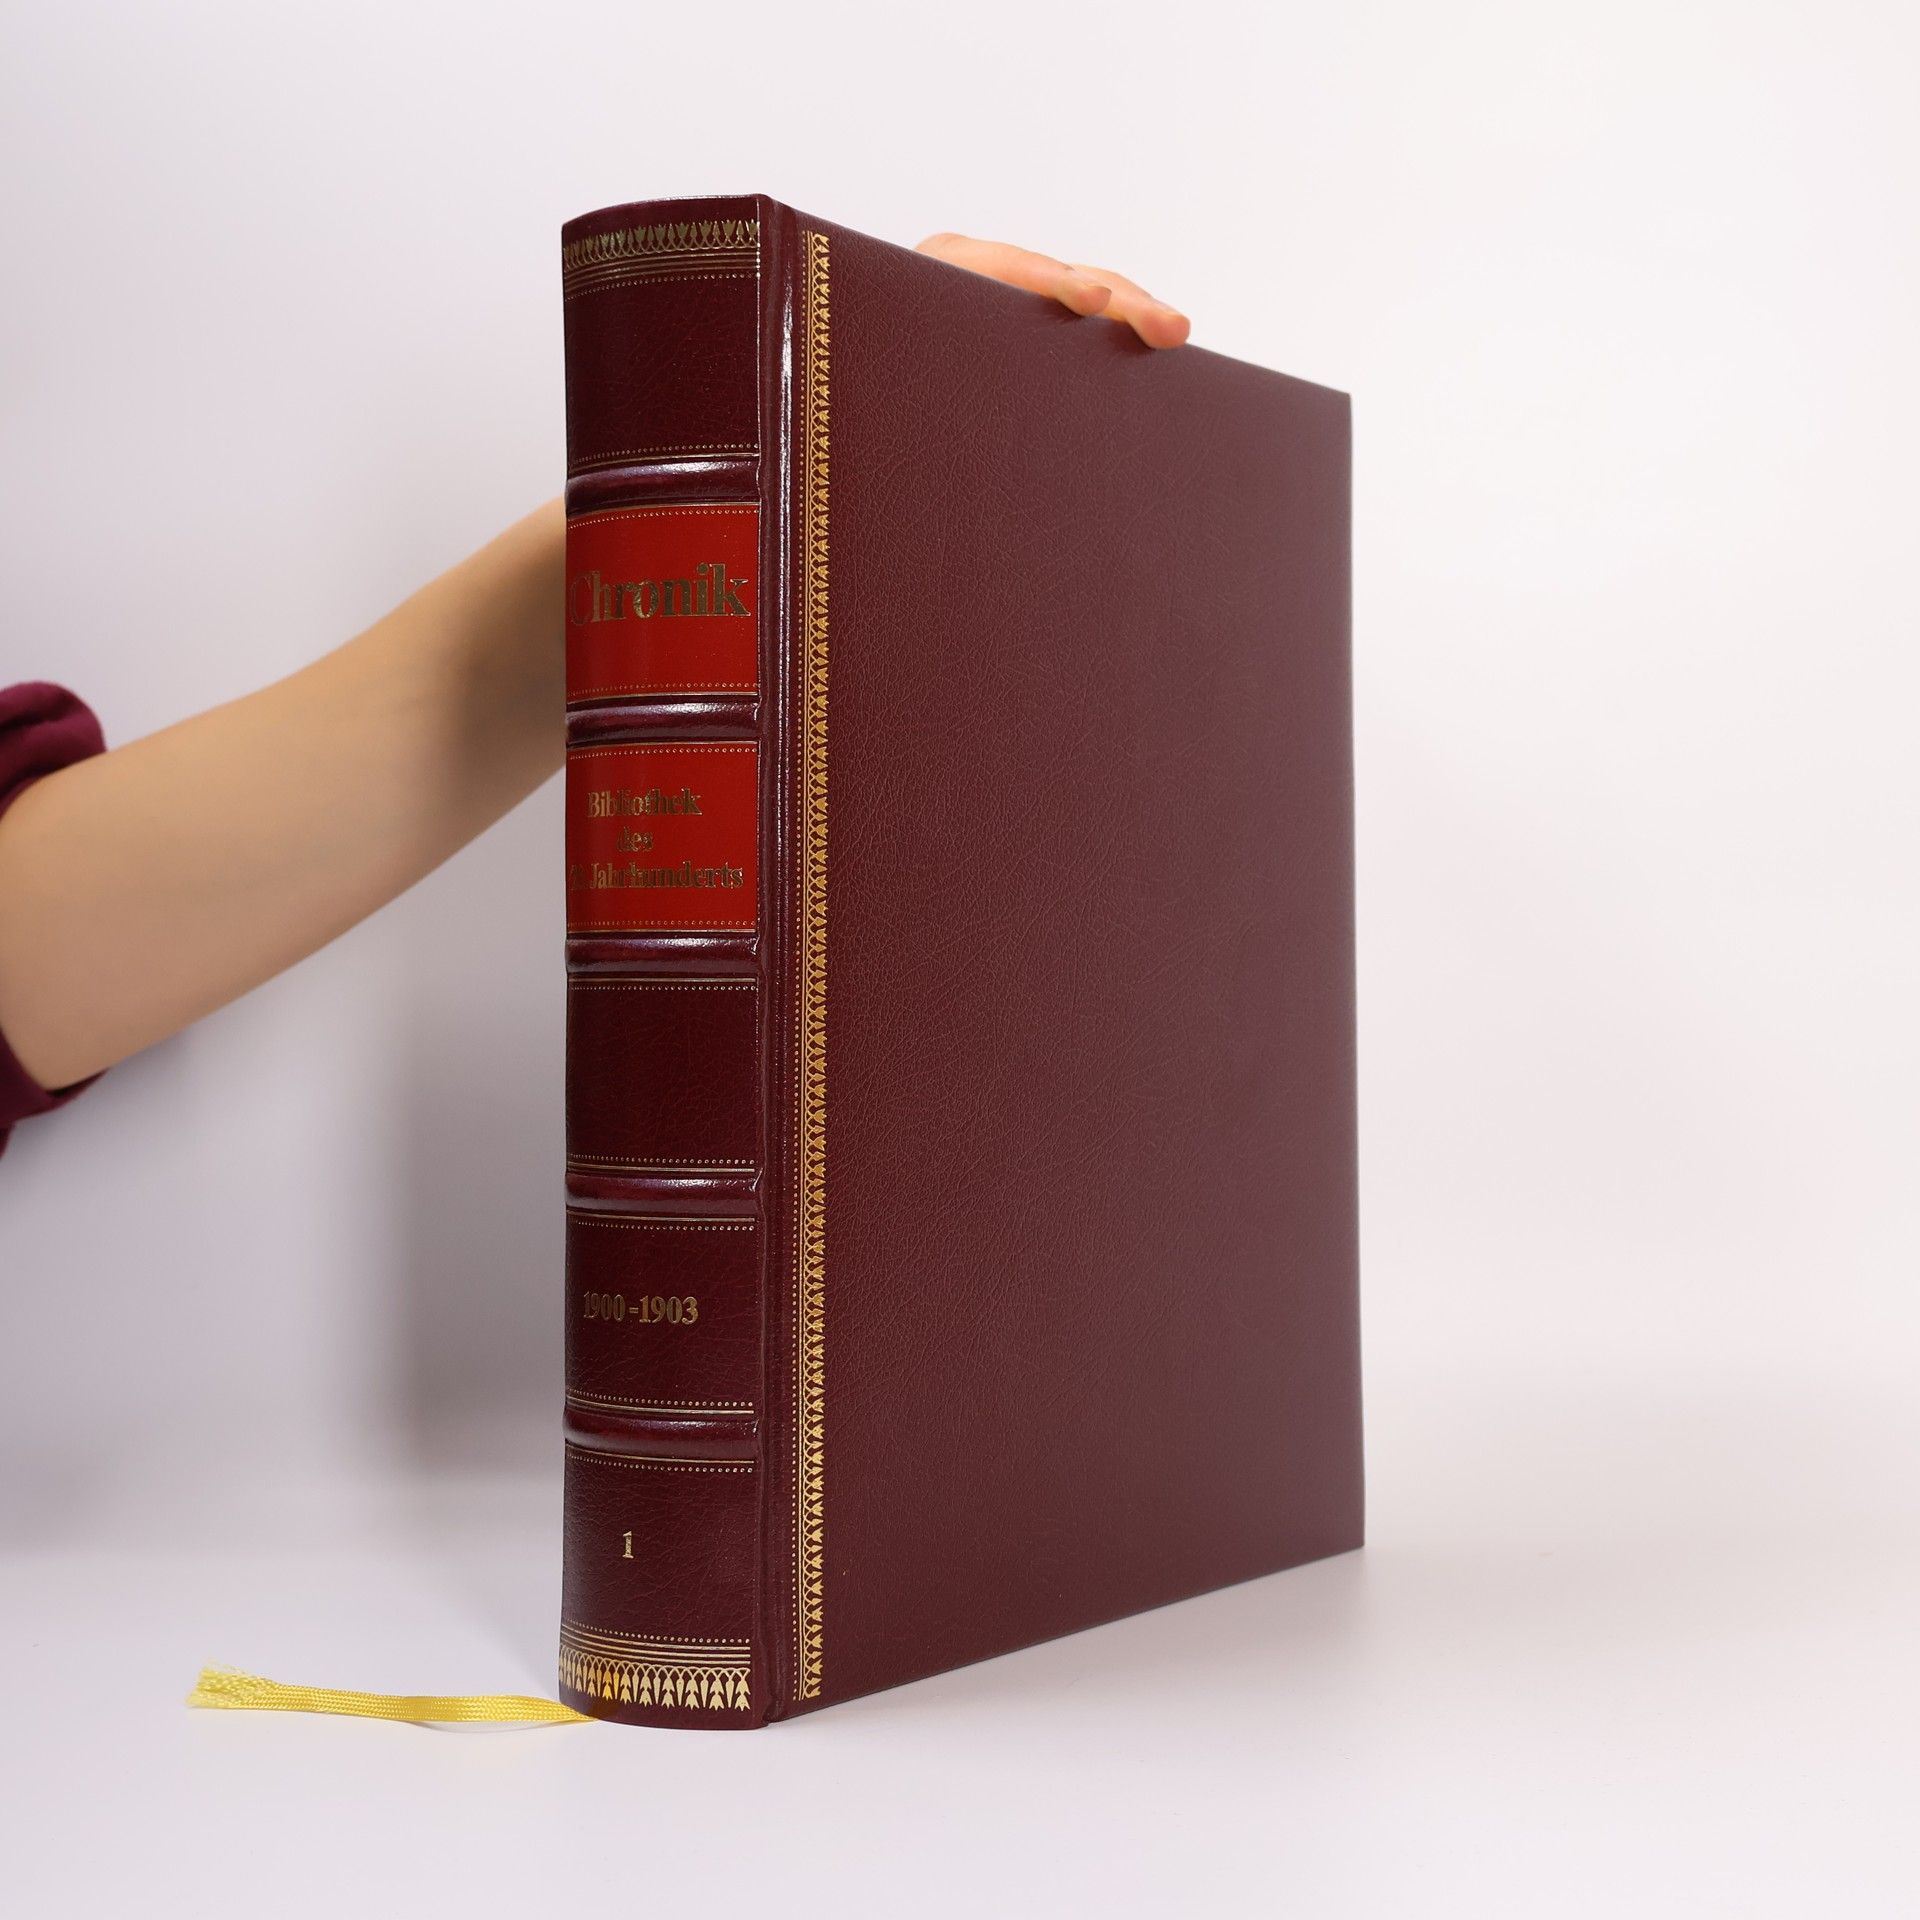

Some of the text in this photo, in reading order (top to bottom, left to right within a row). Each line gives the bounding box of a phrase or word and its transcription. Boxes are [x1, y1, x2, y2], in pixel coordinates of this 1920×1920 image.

[570, 562, 752, 626] Chronik
[587, 788, 703, 818] Bibliothek
[617, 827, 653, 852] des
[590, 860, 744, 890] Jahrhunderts
[622, 1531, 634, 1559] 1
